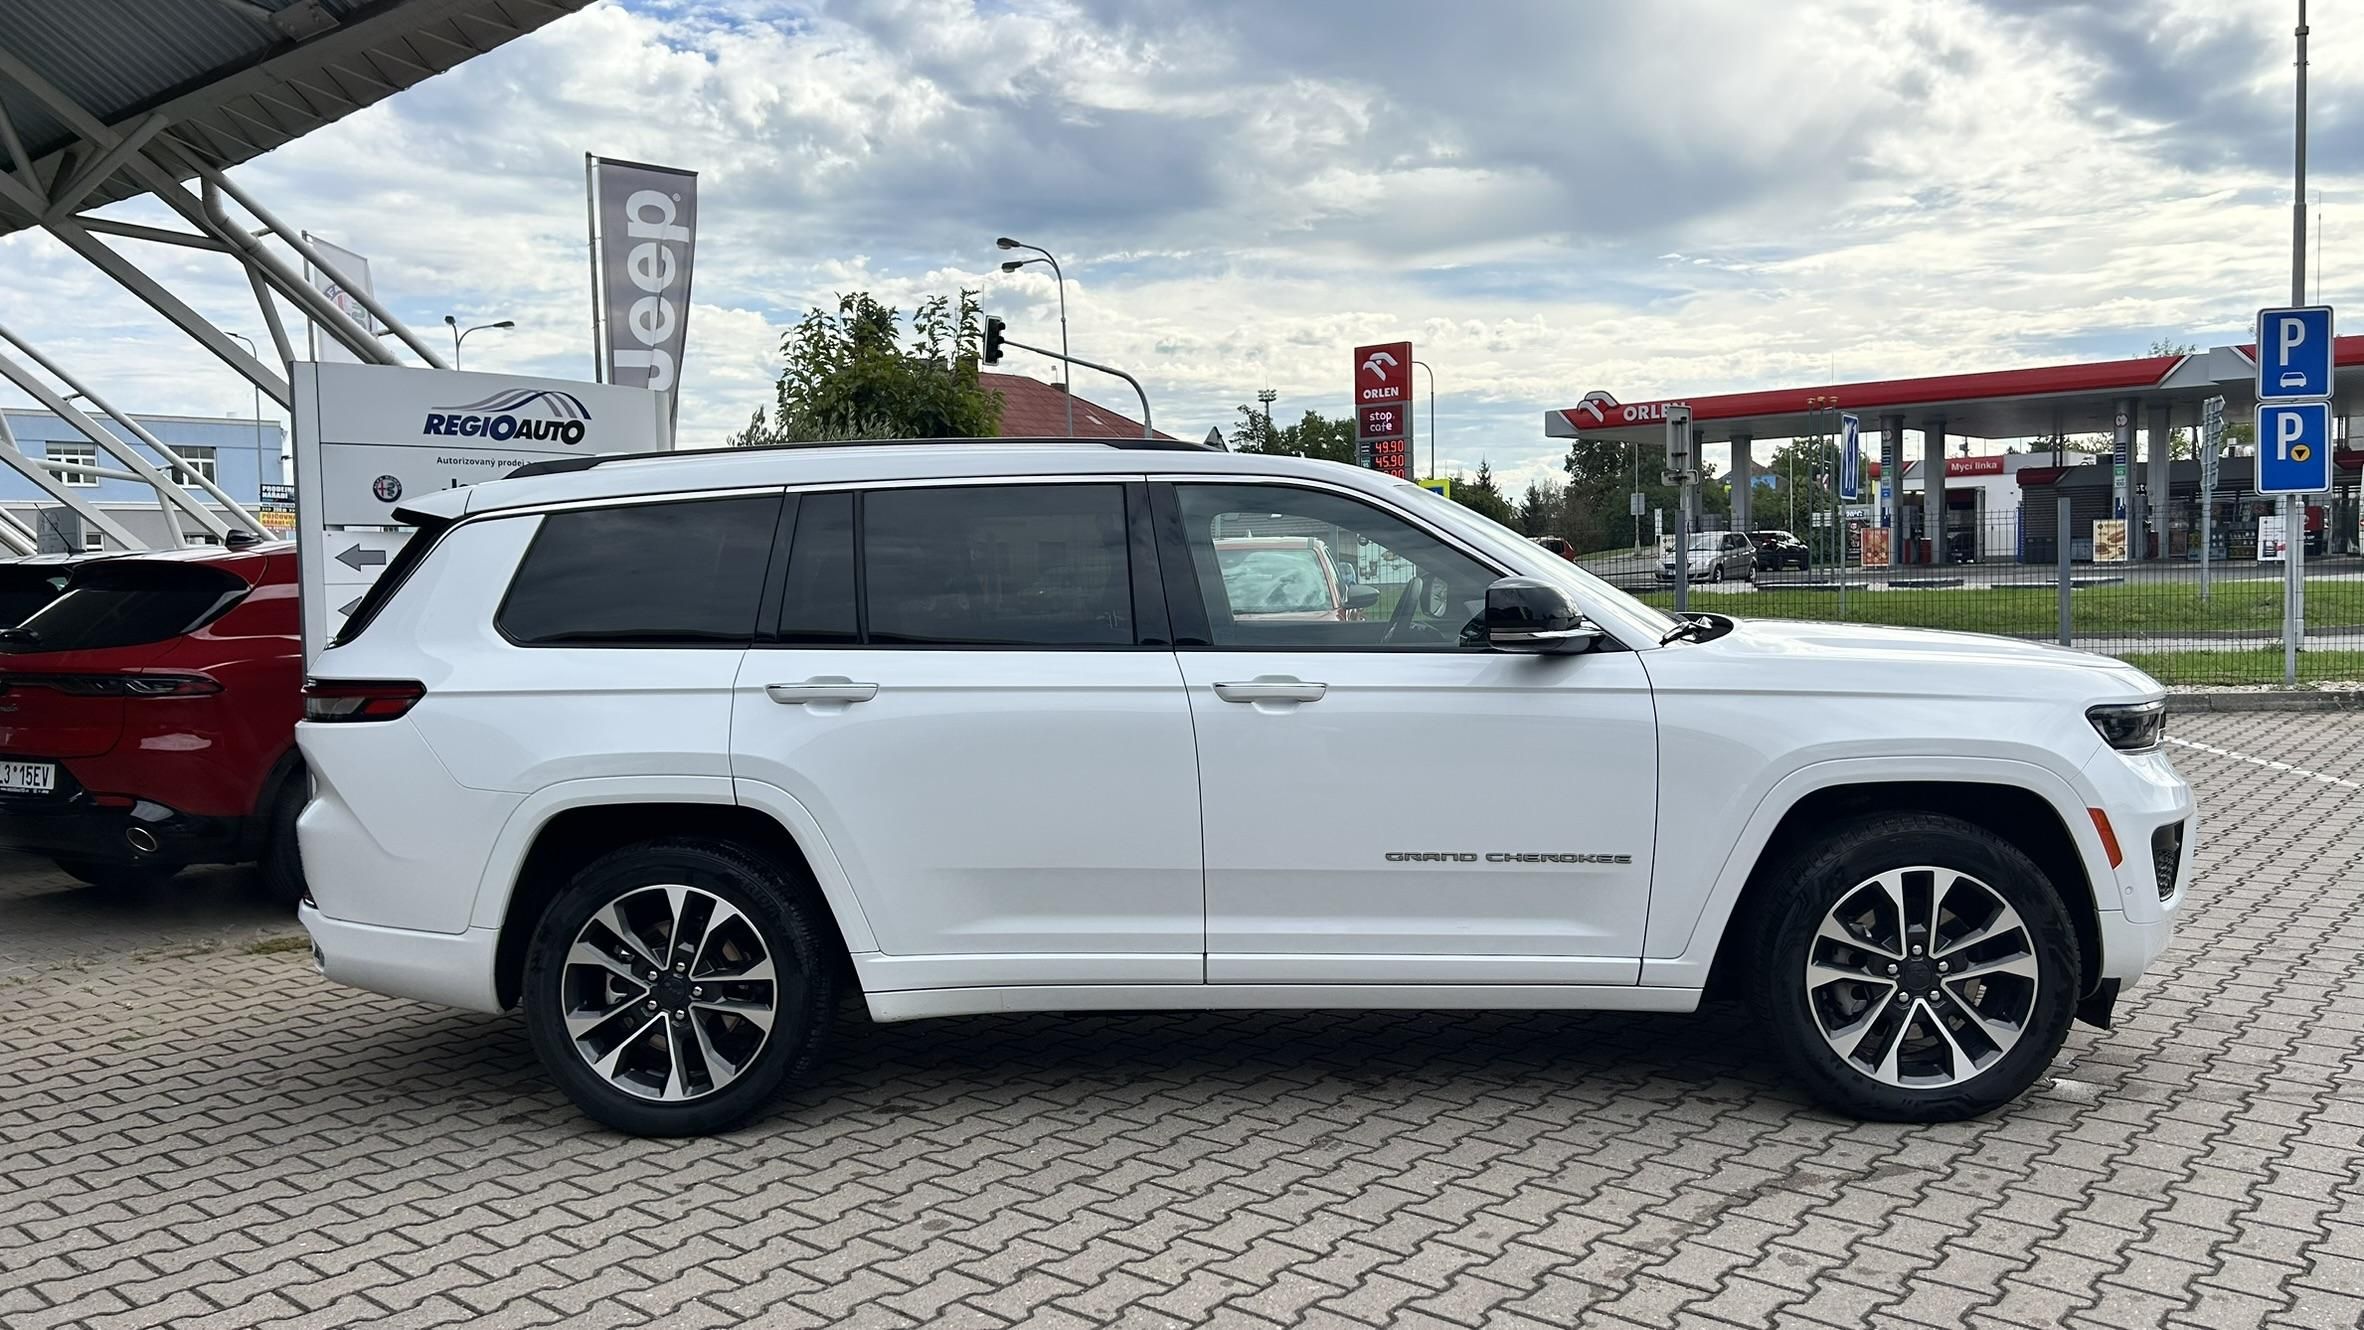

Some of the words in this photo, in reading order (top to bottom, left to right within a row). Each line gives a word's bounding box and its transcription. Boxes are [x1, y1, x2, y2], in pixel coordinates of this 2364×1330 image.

[613, 189, 690, 392] Jeep
[2279, 317, 2306, 366] P
[1362, 386, 1400, 399] ORLEN
[1369, 411, 1393, 423] stop
[1623, 401, 1686, 421] ORLE
[423, 413, 586, 445] REGIOAUTO
[2276, 412, 2304, 460] P
[1375, 440, 1405, 454] 49.90
[436, 456, 496, 467] Autorizovaný
[497, 458, 525, 468] prodej
[1375, 455, 1405, 468] 45.90
[1974, 461, 1998, 470] linka
[20, 764, 49, 787] 15EV
[1385, 852, 1478, 862] GRAND
[1485, 852, 1633, 864] CHEROKEE
